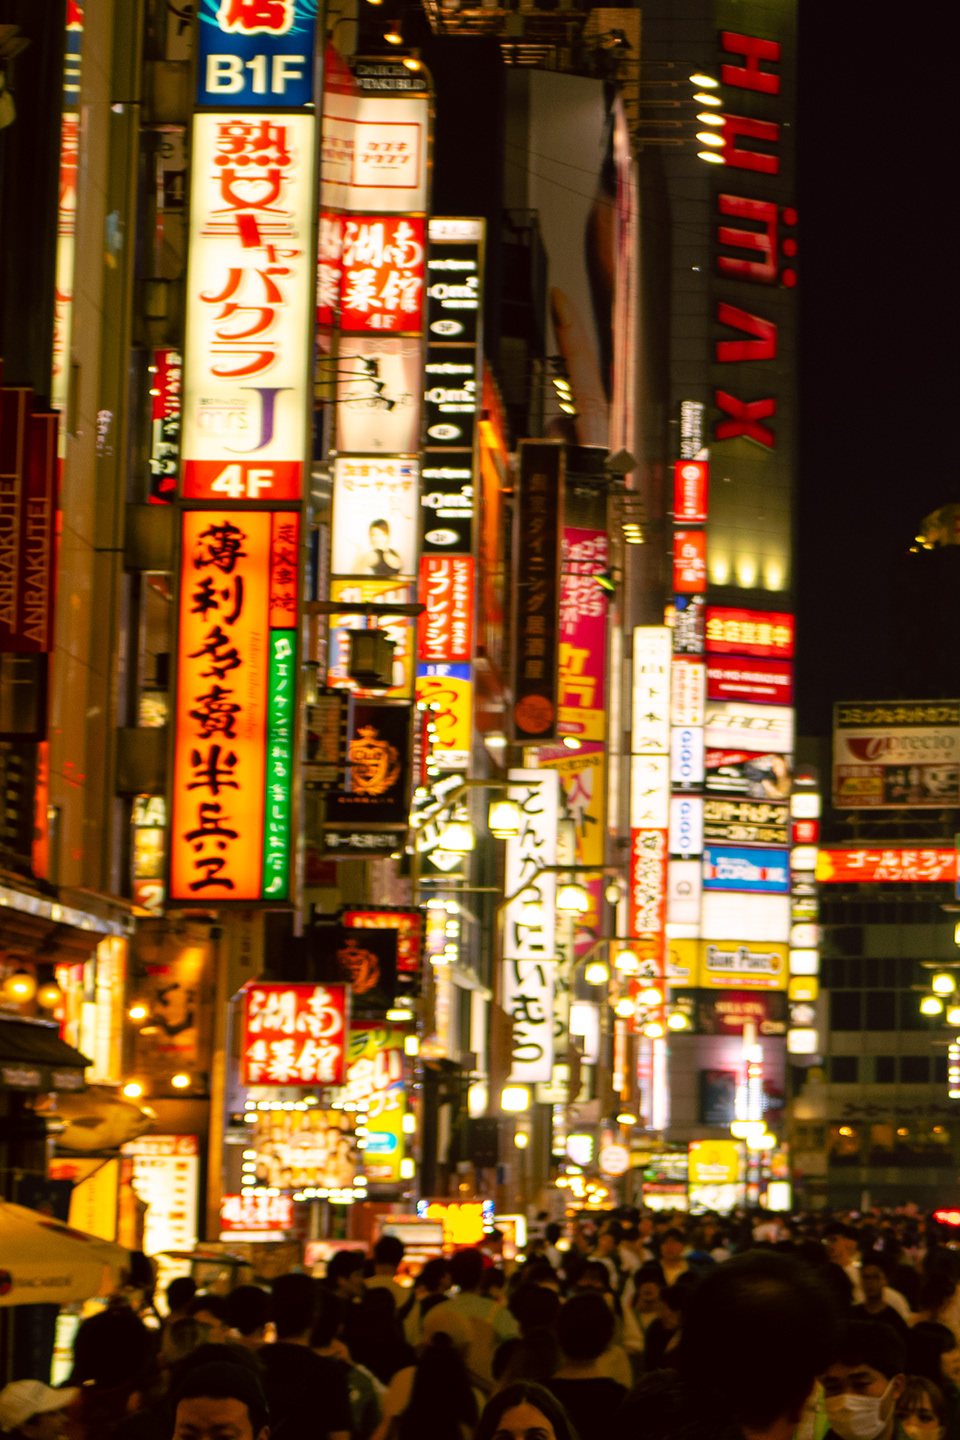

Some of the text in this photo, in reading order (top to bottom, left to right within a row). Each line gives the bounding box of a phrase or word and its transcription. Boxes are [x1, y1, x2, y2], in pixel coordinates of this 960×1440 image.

[205, 53, 306, 95] B1F
[199, 119, 303, 378] 熟女キャバクラ
[344, 220, 423, 269] 湖南
[342, 268, 424, 313] 菜館
[365, 313, 397, 329] 4F
[210, 464, 274, 498] 4F
[23, 497, 49, 643] ANRAKUTEI
[248, 988, 343, 1038] 湖南
[270, 1038, 340, 1083] 菜館
